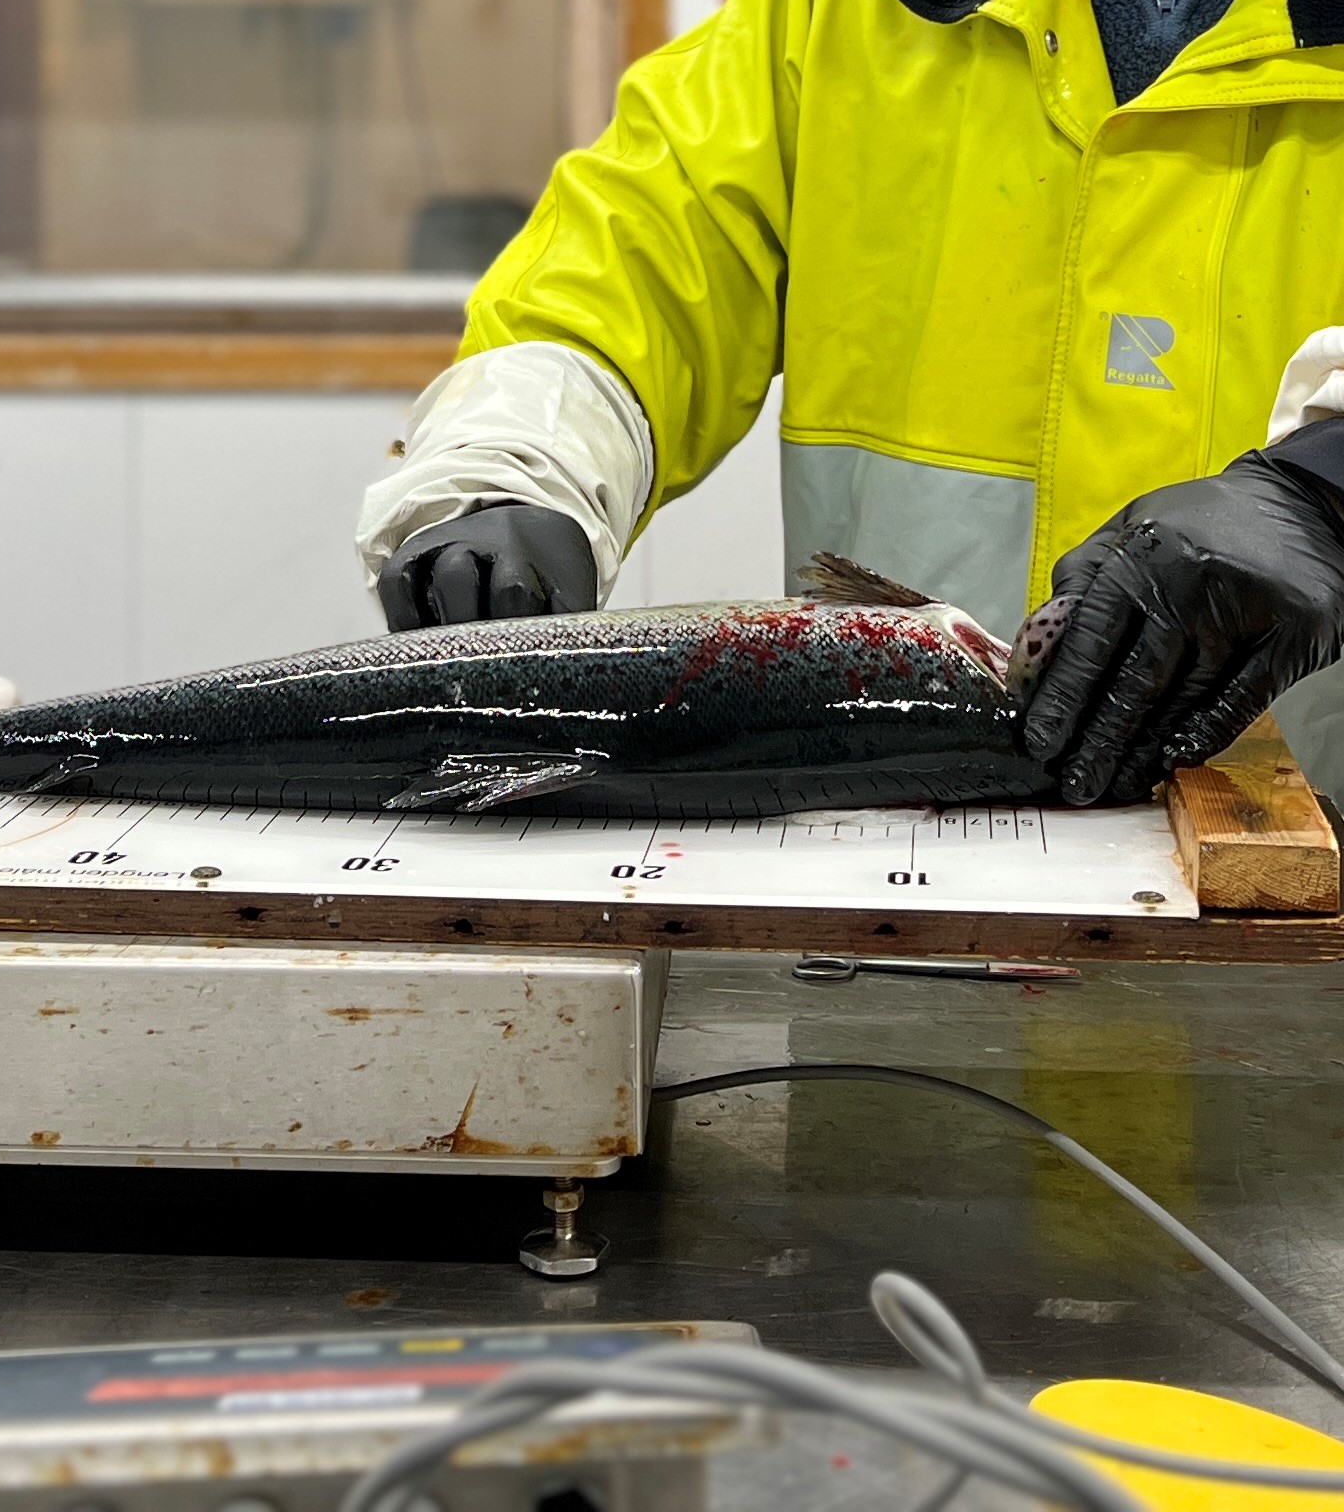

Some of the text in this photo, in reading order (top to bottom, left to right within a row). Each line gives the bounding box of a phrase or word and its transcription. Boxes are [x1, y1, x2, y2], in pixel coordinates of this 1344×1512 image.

[1107, 368, 1165, 385] Regatta
[944, 817, 1034, 827] 5 6 7 8
[67, 850, 128, 865] 40
[340, 856, 401, 872] 30
[70, 869, 187, 879] Lengden
[609, 864, 667, 880] 20
[887, 871, 932, 886] 10
